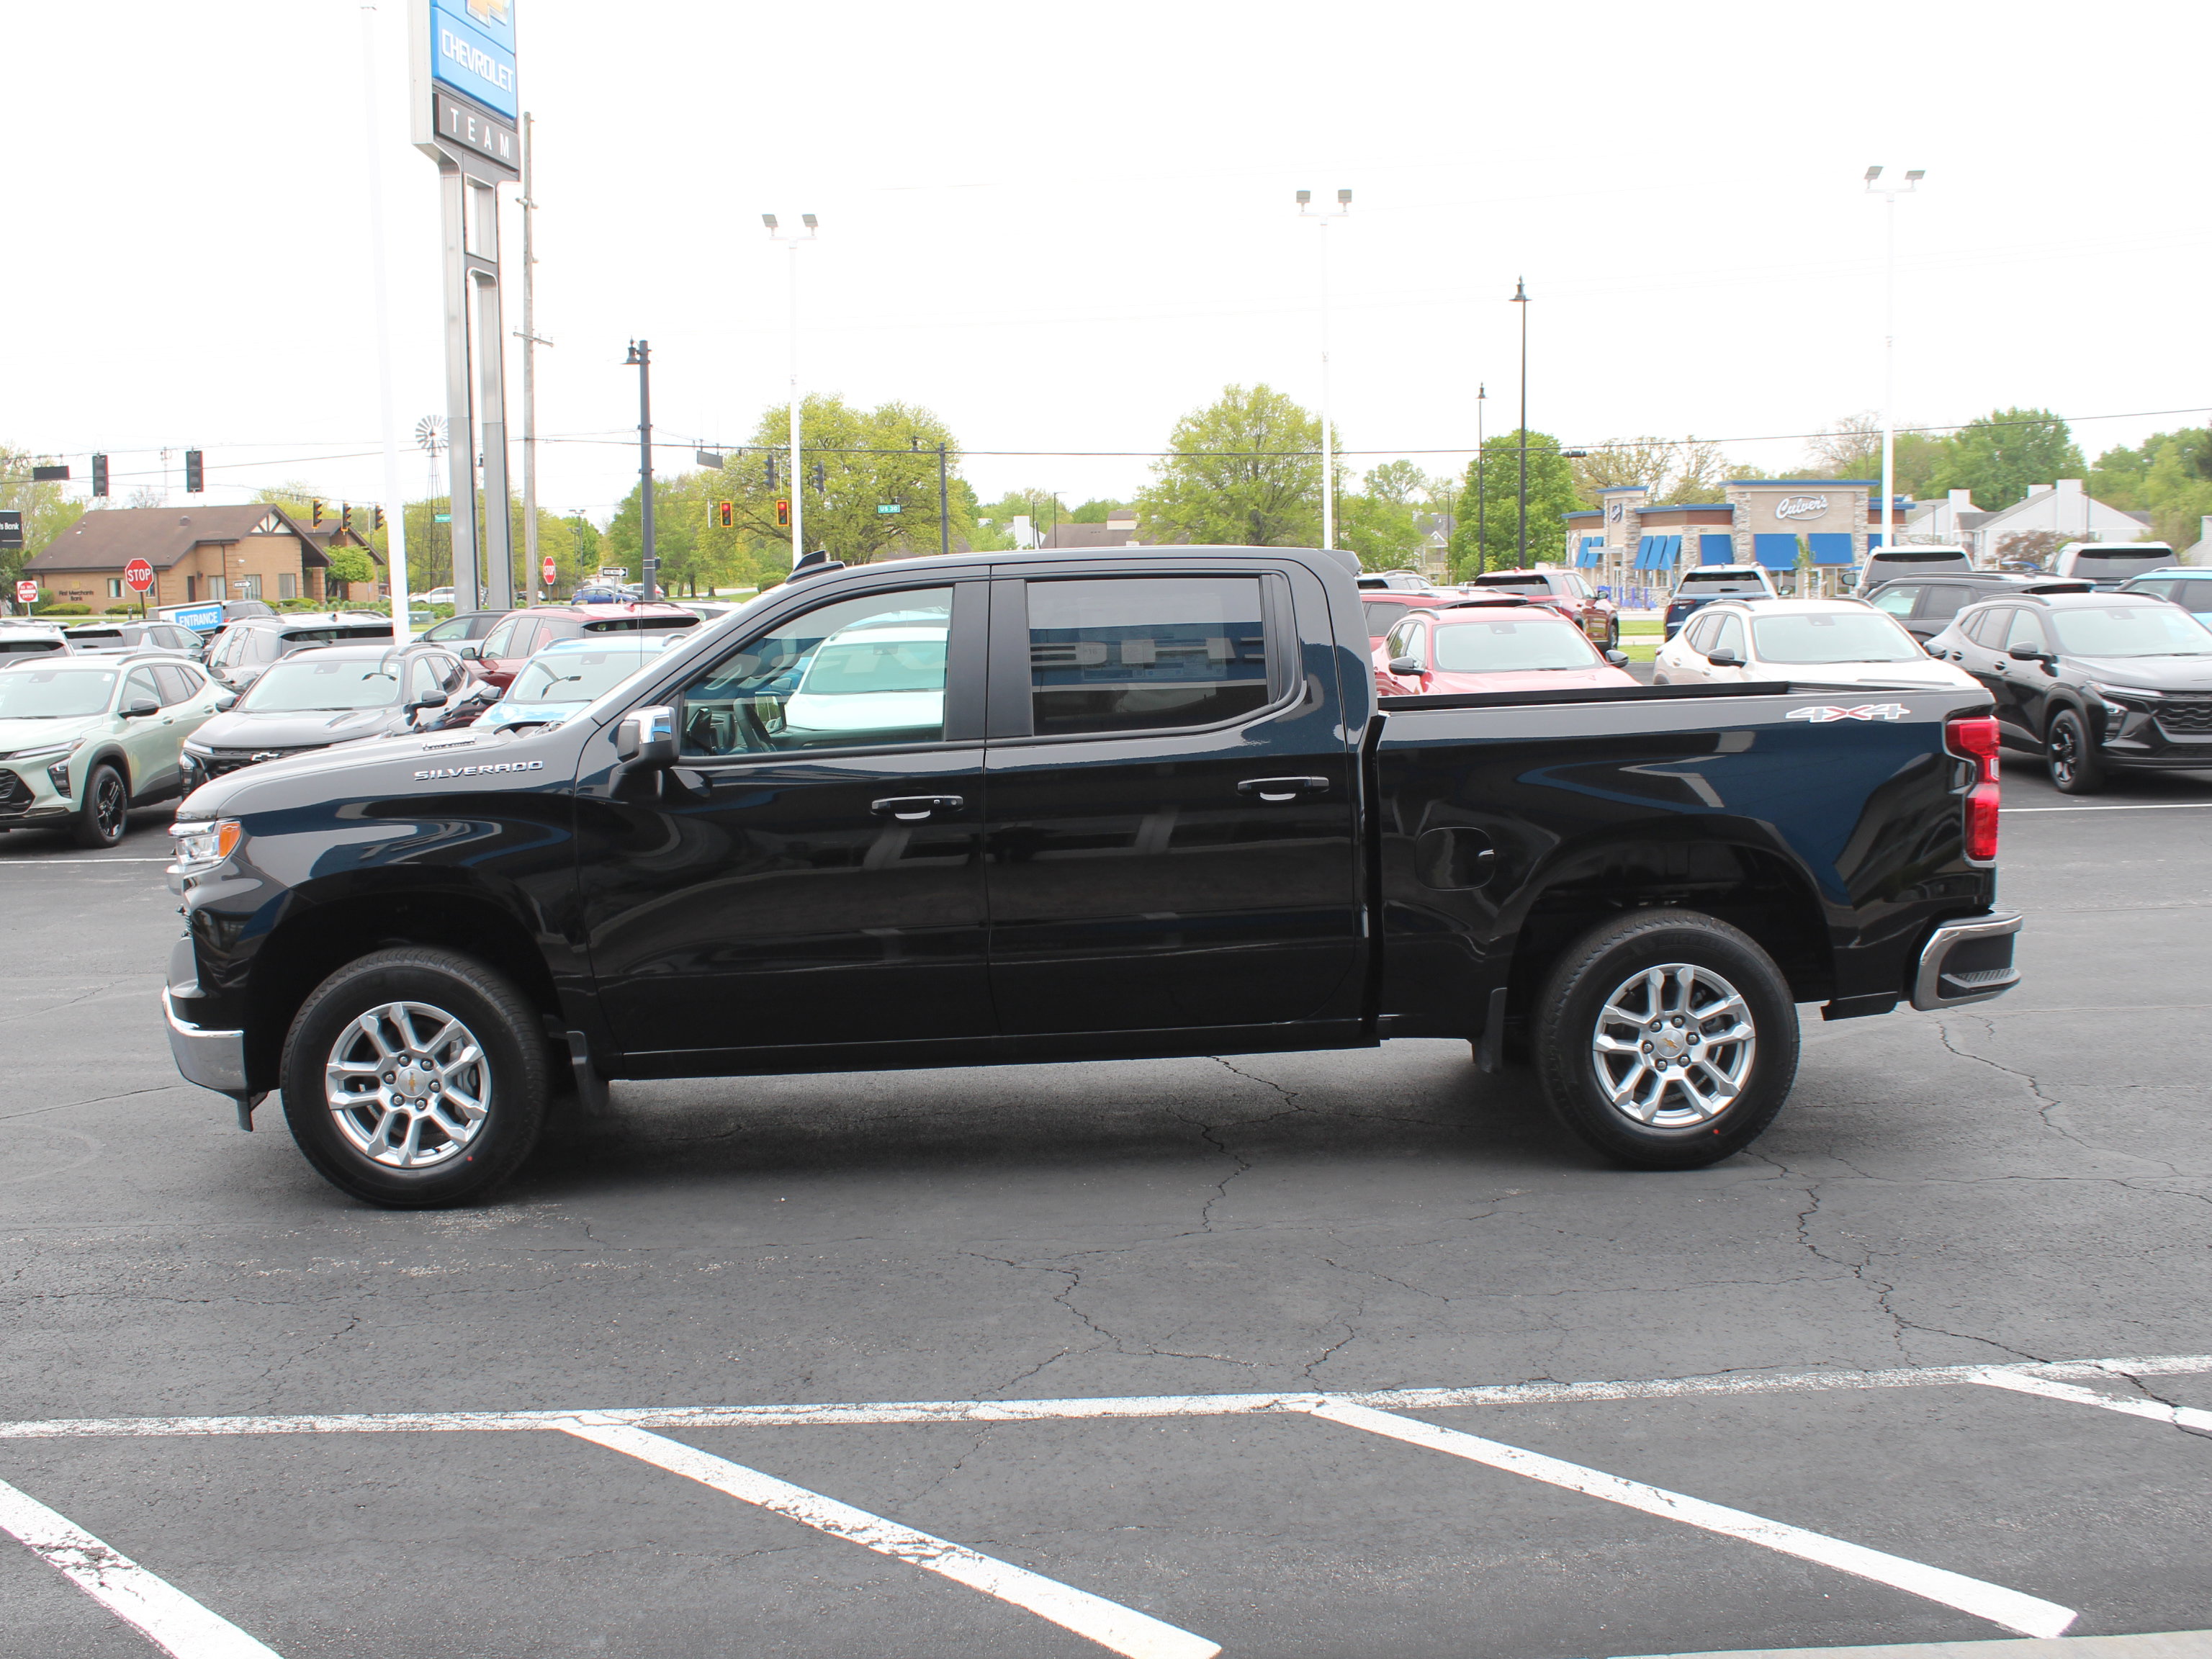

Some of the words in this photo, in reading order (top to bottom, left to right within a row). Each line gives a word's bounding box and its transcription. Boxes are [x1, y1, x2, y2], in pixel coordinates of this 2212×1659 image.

[441, 29, 513, 94] CHEVROLET
[450, 107, 510, 159] TEAM
[1775, 495, 1829, 519] Culver's
[127, 568, 151, 582] STOP
[544, 565, 554, 576] STOP
[179, 611, 218, 627] ENTRANCE
[413, 760, 544, 781] SILVERADO
